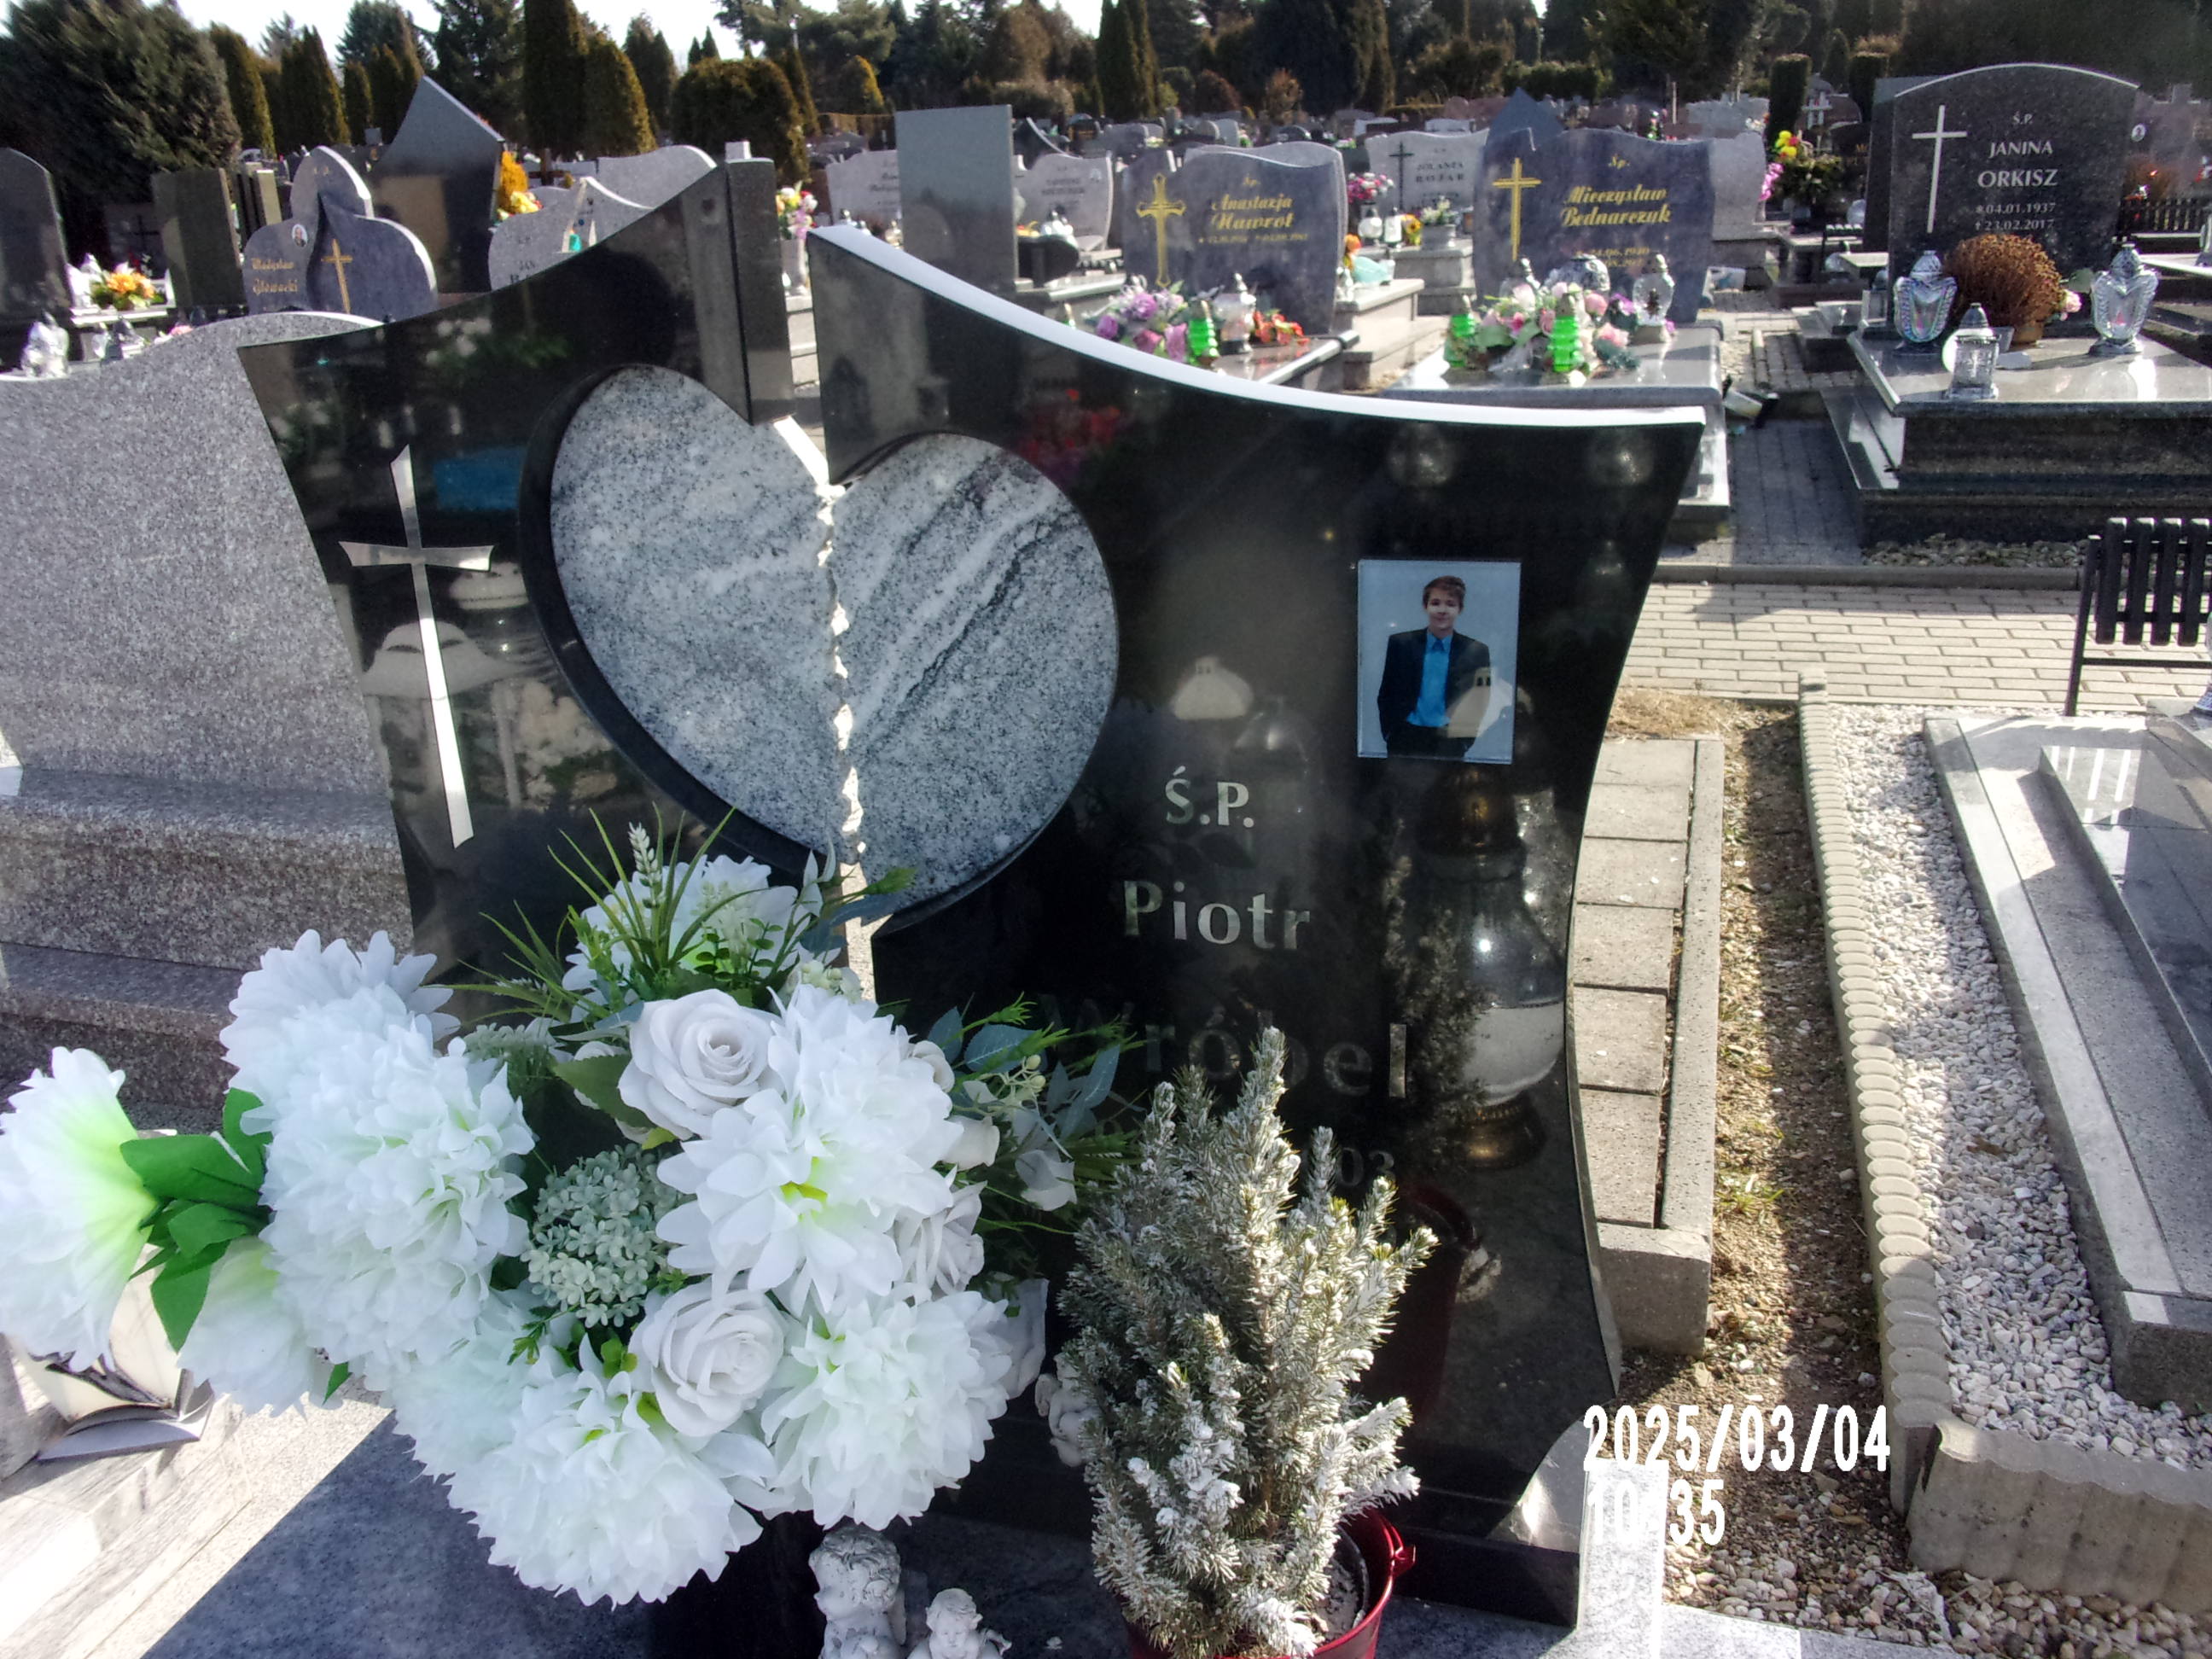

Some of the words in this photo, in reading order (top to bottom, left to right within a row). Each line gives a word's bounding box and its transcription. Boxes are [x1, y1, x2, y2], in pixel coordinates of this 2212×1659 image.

[1988, 139, 2054, 160] JANINA
[1976, 168, 2059, 189] ORKISZ
[1165, 765, 1254, 828] Ś.P.
[1124, 880, 1312, 950] Piotr
